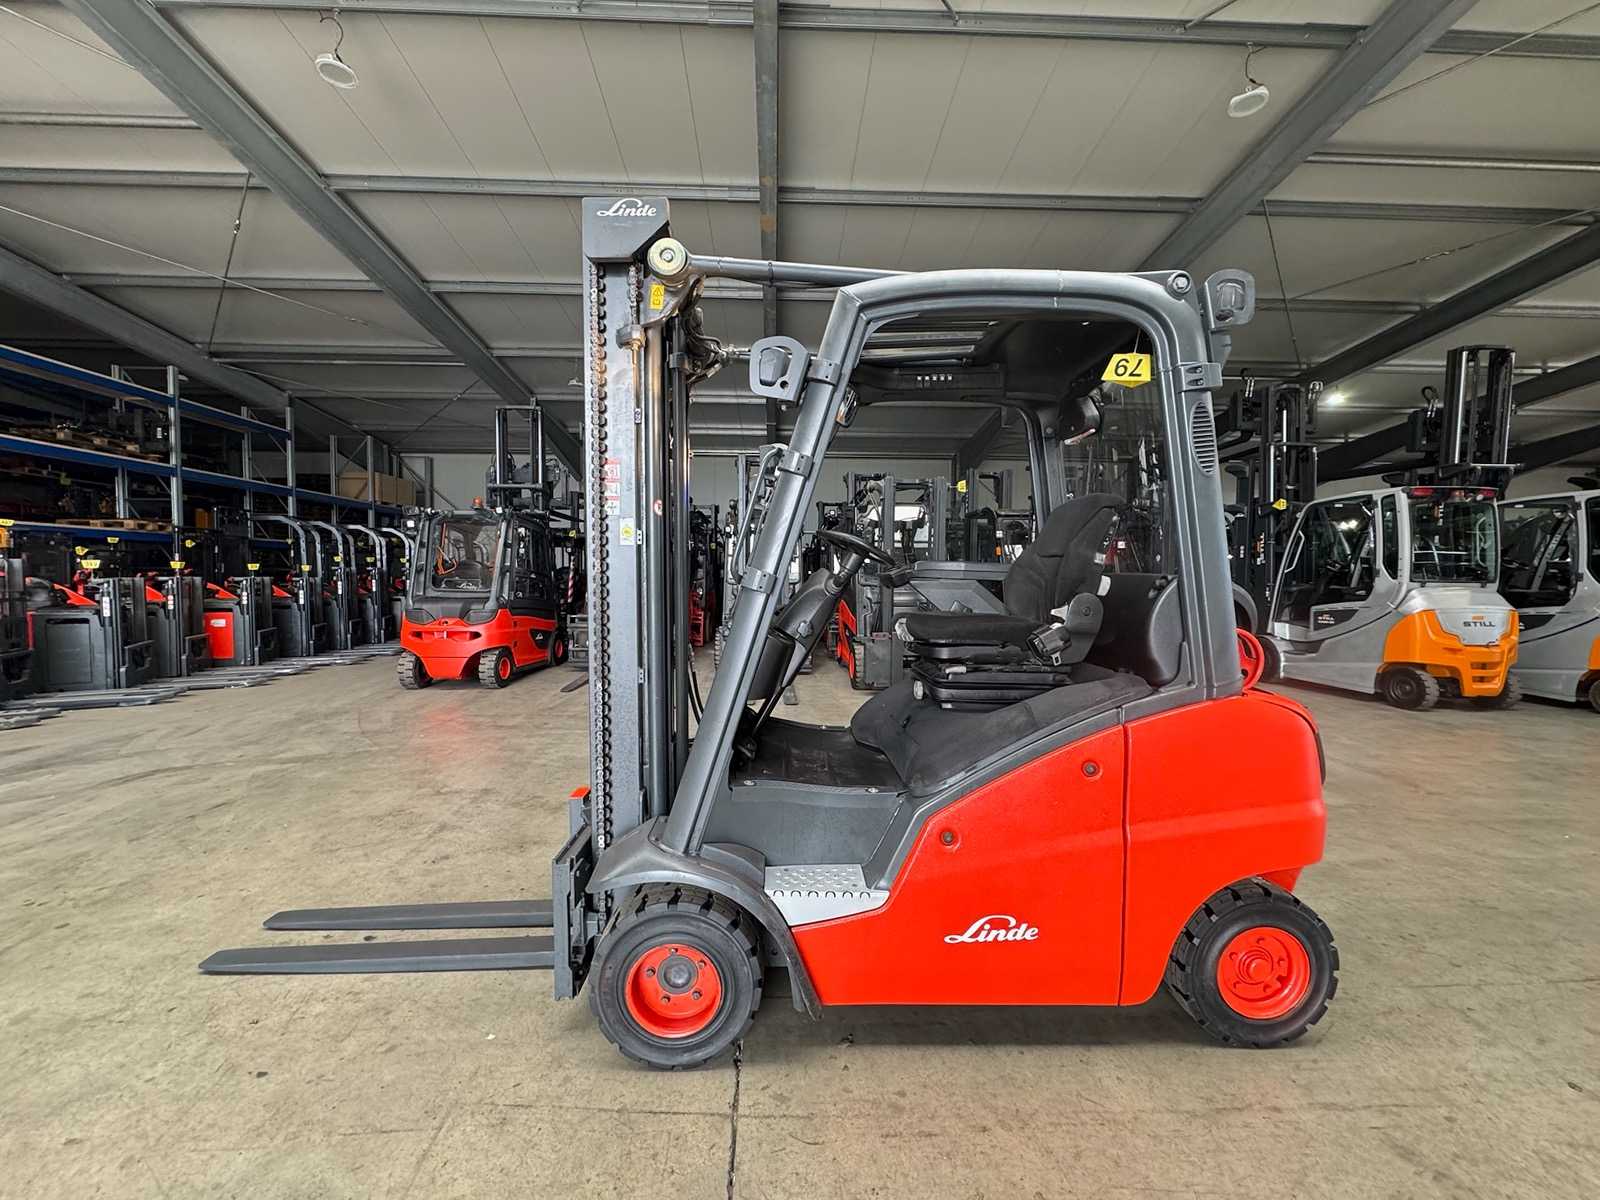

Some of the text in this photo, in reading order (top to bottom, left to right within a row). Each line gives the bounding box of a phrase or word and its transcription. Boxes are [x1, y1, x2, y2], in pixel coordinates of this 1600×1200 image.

[597, 198, 657, 217] Linde
[1114, 358, 1144, 377] 79
[944, 914, 1039, 944] Linde
